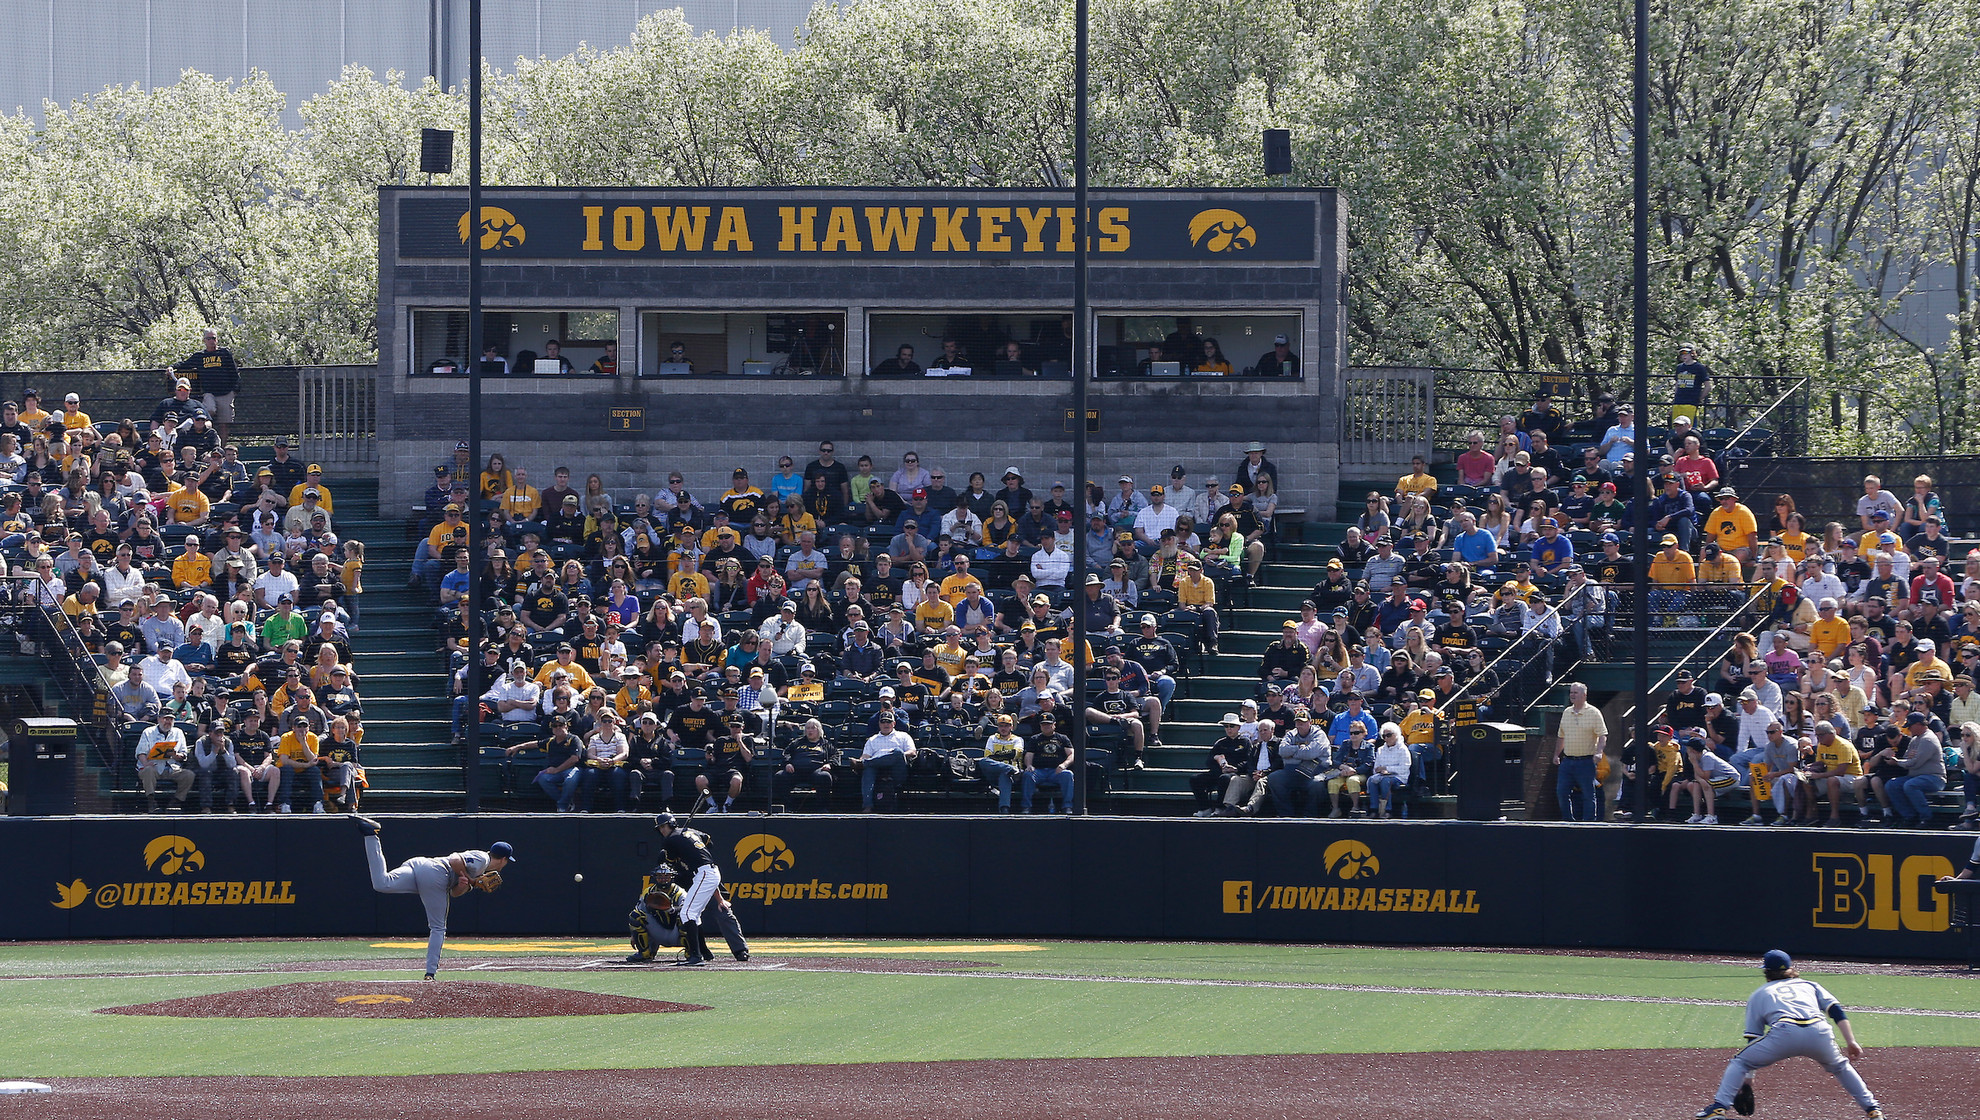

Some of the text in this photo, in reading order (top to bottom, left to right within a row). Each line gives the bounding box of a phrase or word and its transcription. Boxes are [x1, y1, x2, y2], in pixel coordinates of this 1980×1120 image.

[582, 206, 1131, 252] IOWA HAWKEYES
[170, 372, 198, 380] ECTION
[1543, 375, 1573, 383] SECTION
[1552, 384, 1559, 393] C
[612, 409, 642, 417] SECTION
[1067, 411, 1097, 419] SEION
[622, 418, 630, 429] B
[950, 586, 966, 595] IOW
[1442, 637, 1468, 646] LOYALTY
[1136, 644, 1160, 652] IOWA
[1000, 681, 1019, 689] IOWA
[1310, 718, 1328, 726] OWA
[95, 880, 296, 908] @UIBASEBALL
[642, 876, 889, 906] yesports.com
[1256, 885, 1481, 914] /IOWABASEBALL
